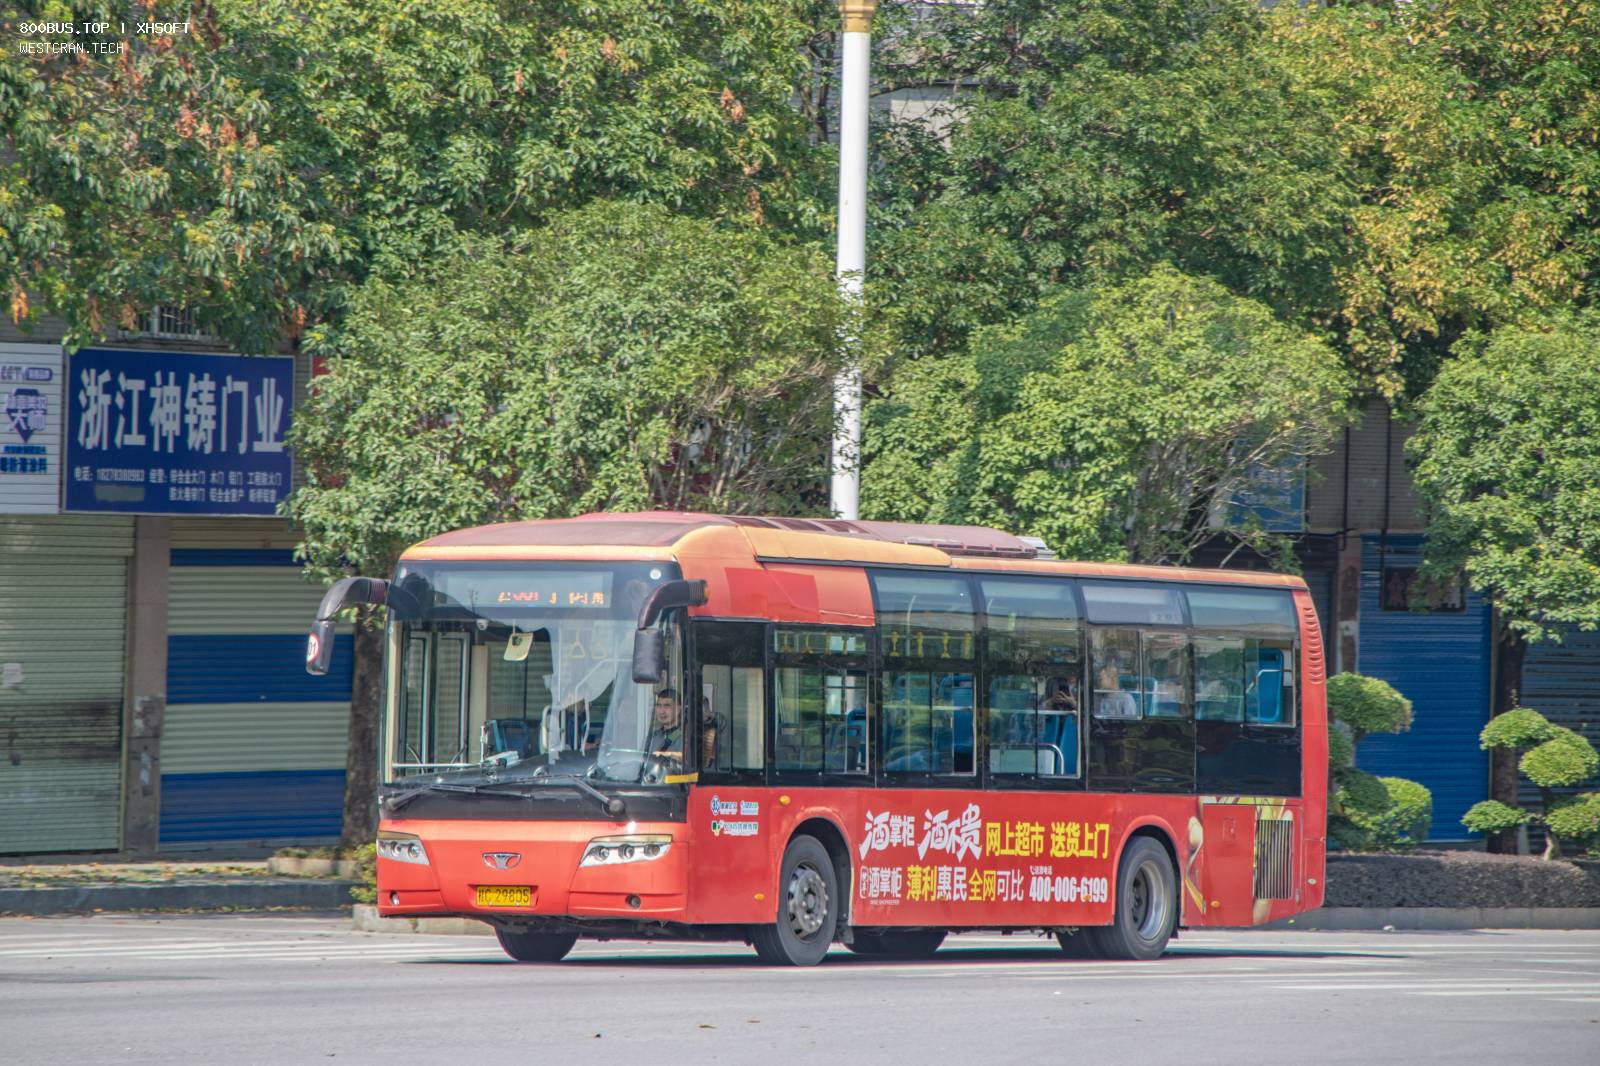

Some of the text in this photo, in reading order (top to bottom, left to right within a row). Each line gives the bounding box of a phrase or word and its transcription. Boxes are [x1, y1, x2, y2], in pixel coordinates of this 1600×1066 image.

[77, 367, 284, 455] 浙江神铸门业
[859, 802, 1110, 862] 酒掌柜 酒不贵 网上超市 送货上门
[868, 866, 903, 898] 酒掌柜
[1029, 876, 1109, 904] 400-006-6199
